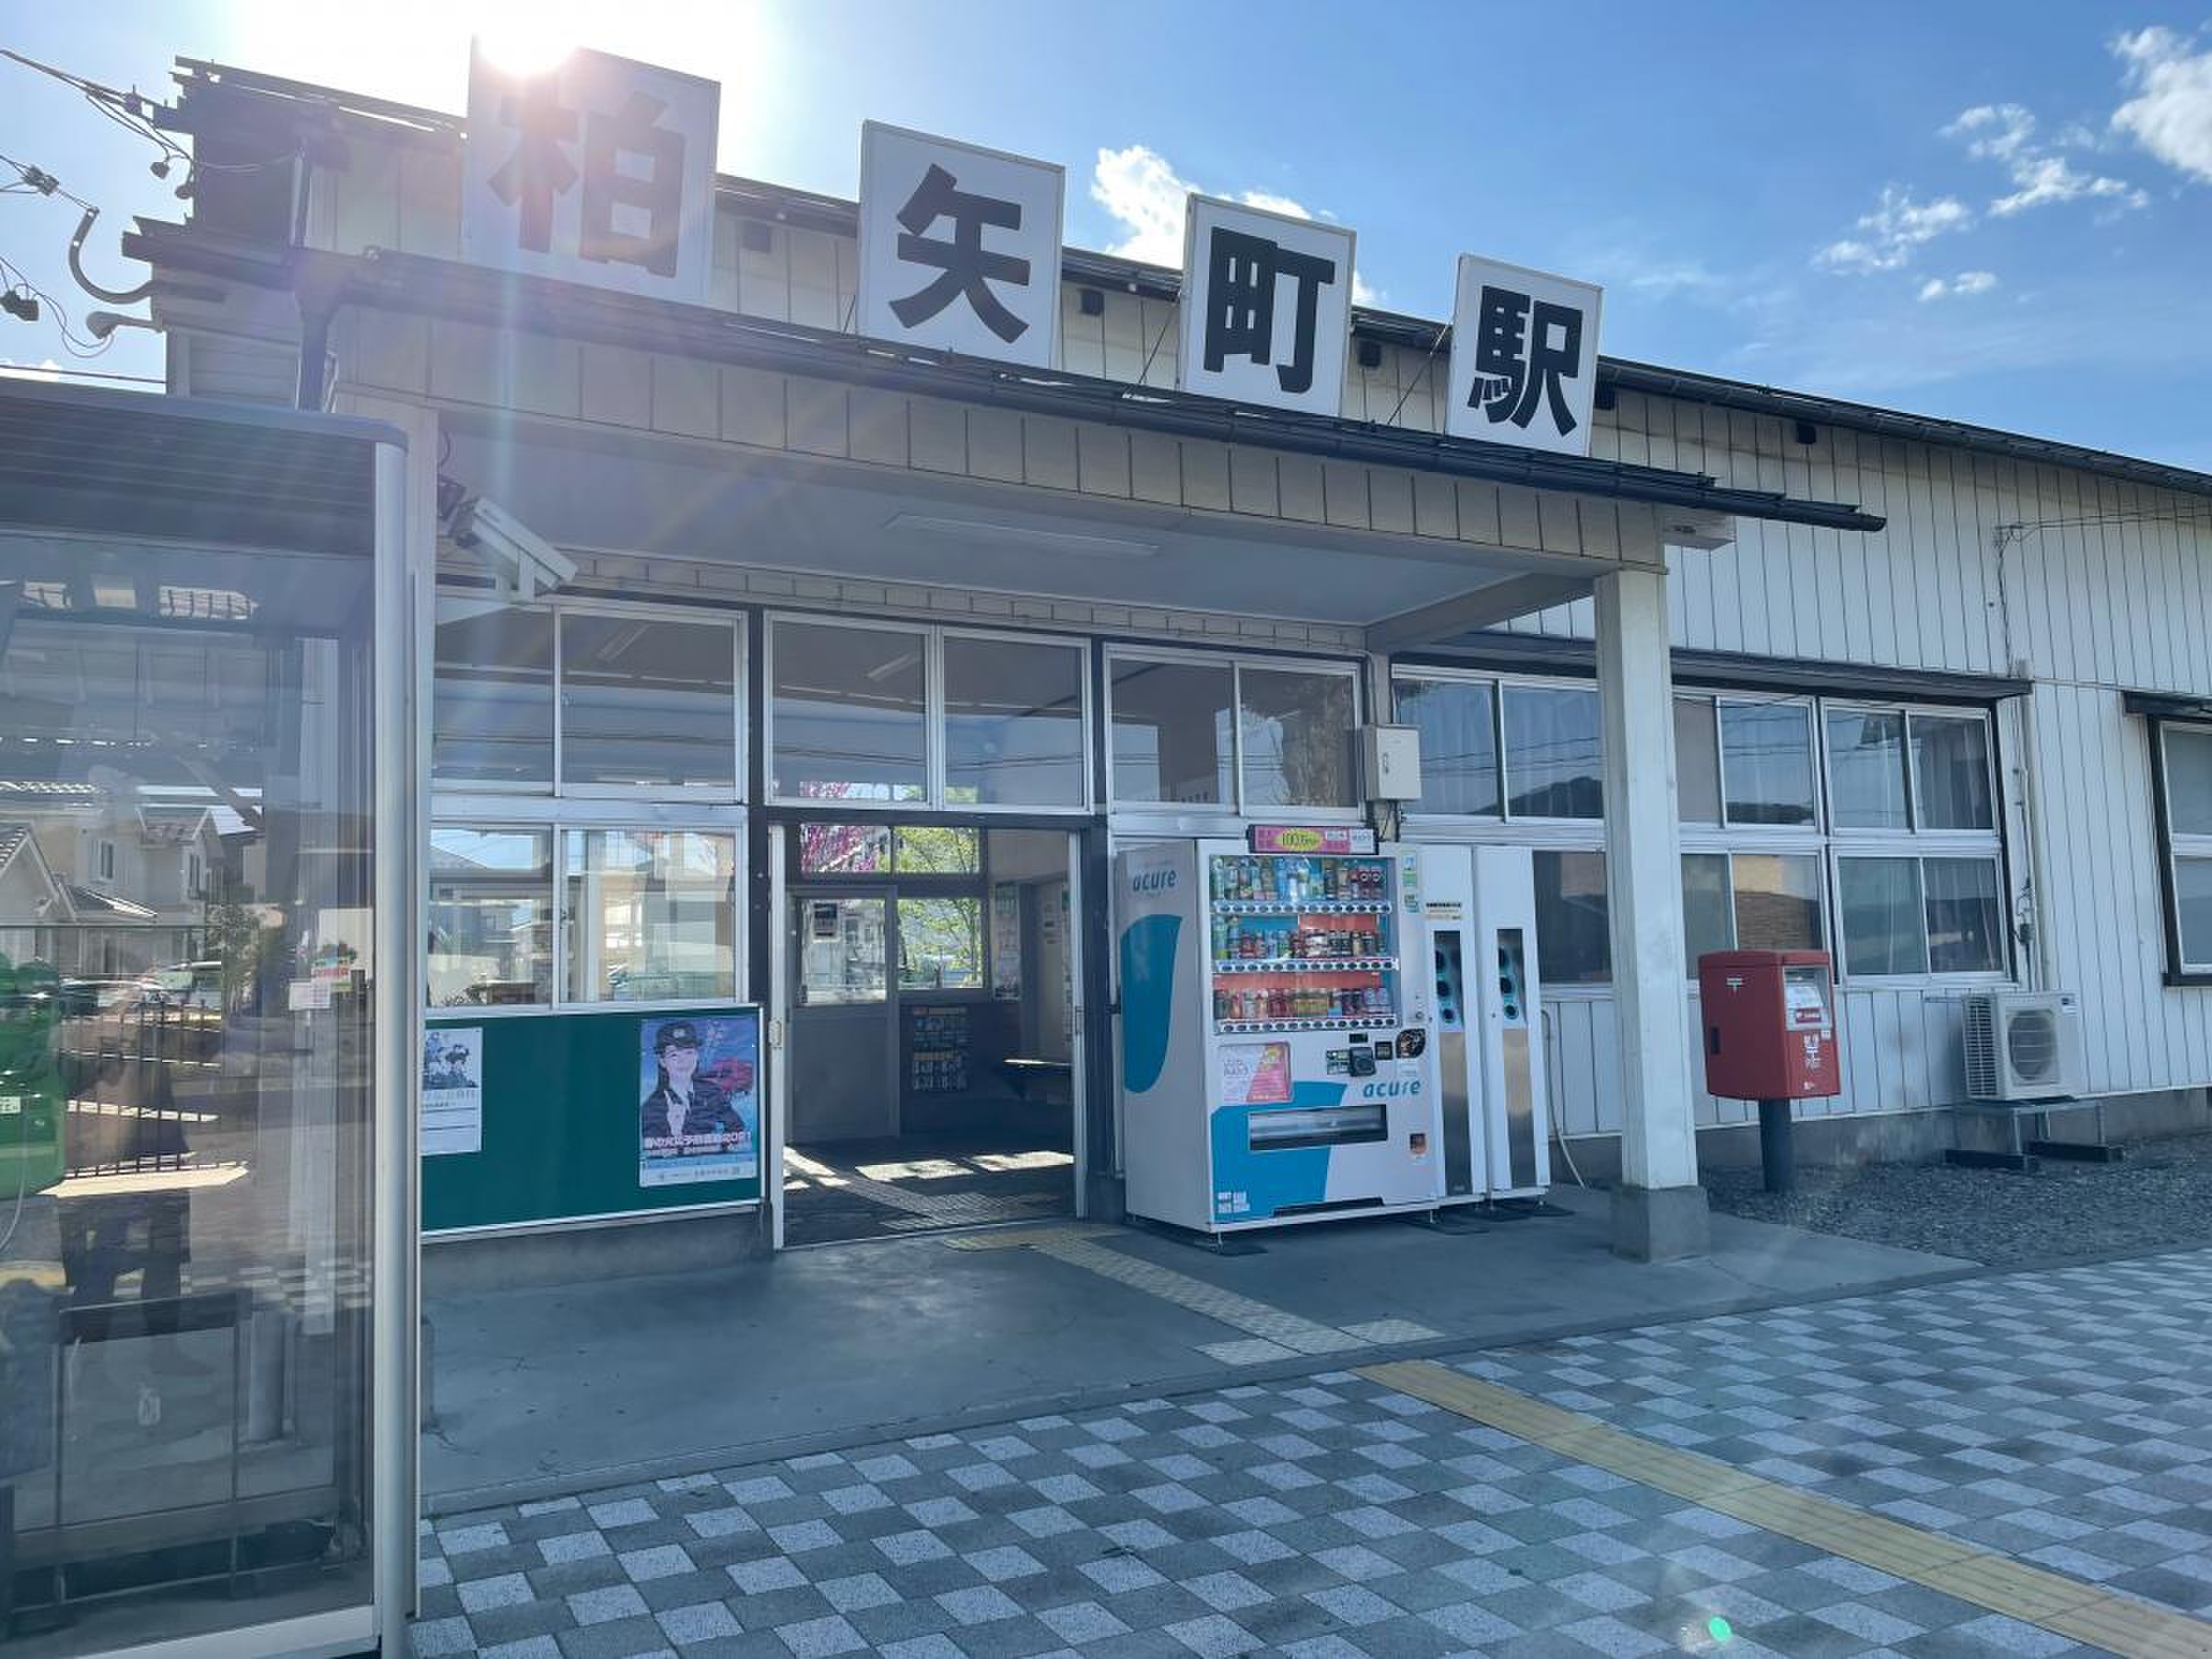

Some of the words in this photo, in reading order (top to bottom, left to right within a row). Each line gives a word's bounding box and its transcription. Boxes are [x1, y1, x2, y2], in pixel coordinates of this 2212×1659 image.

[487, 77, 1583, 437] 柏矢町駅
[1133, 870, 1177, 891] acure
[1363, 1080, 1420, 1098] acure
